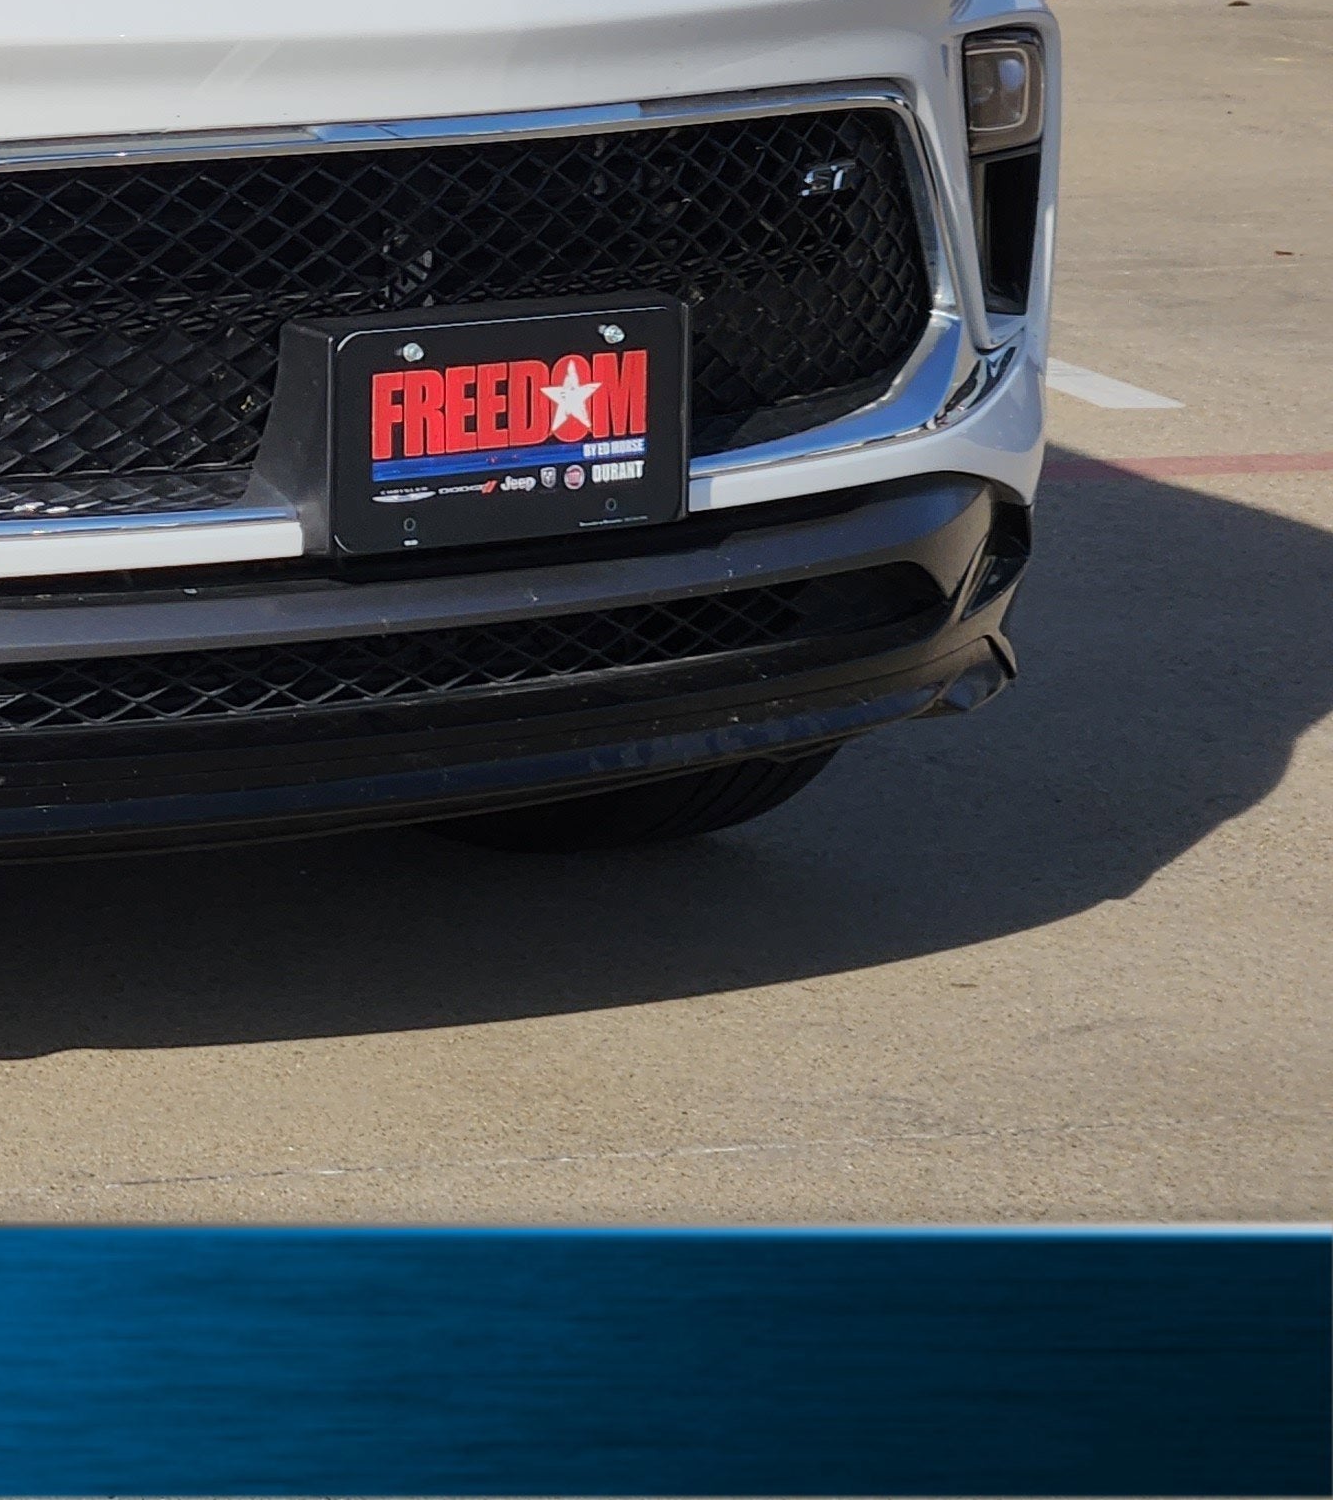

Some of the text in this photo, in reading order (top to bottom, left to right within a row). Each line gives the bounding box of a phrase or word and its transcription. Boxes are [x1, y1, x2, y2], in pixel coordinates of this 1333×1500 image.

[371, 349, 647, 460] FREEDOM
[591, 460, 645, 483] DURANT
[500, 475, 537, 492] Jeep
